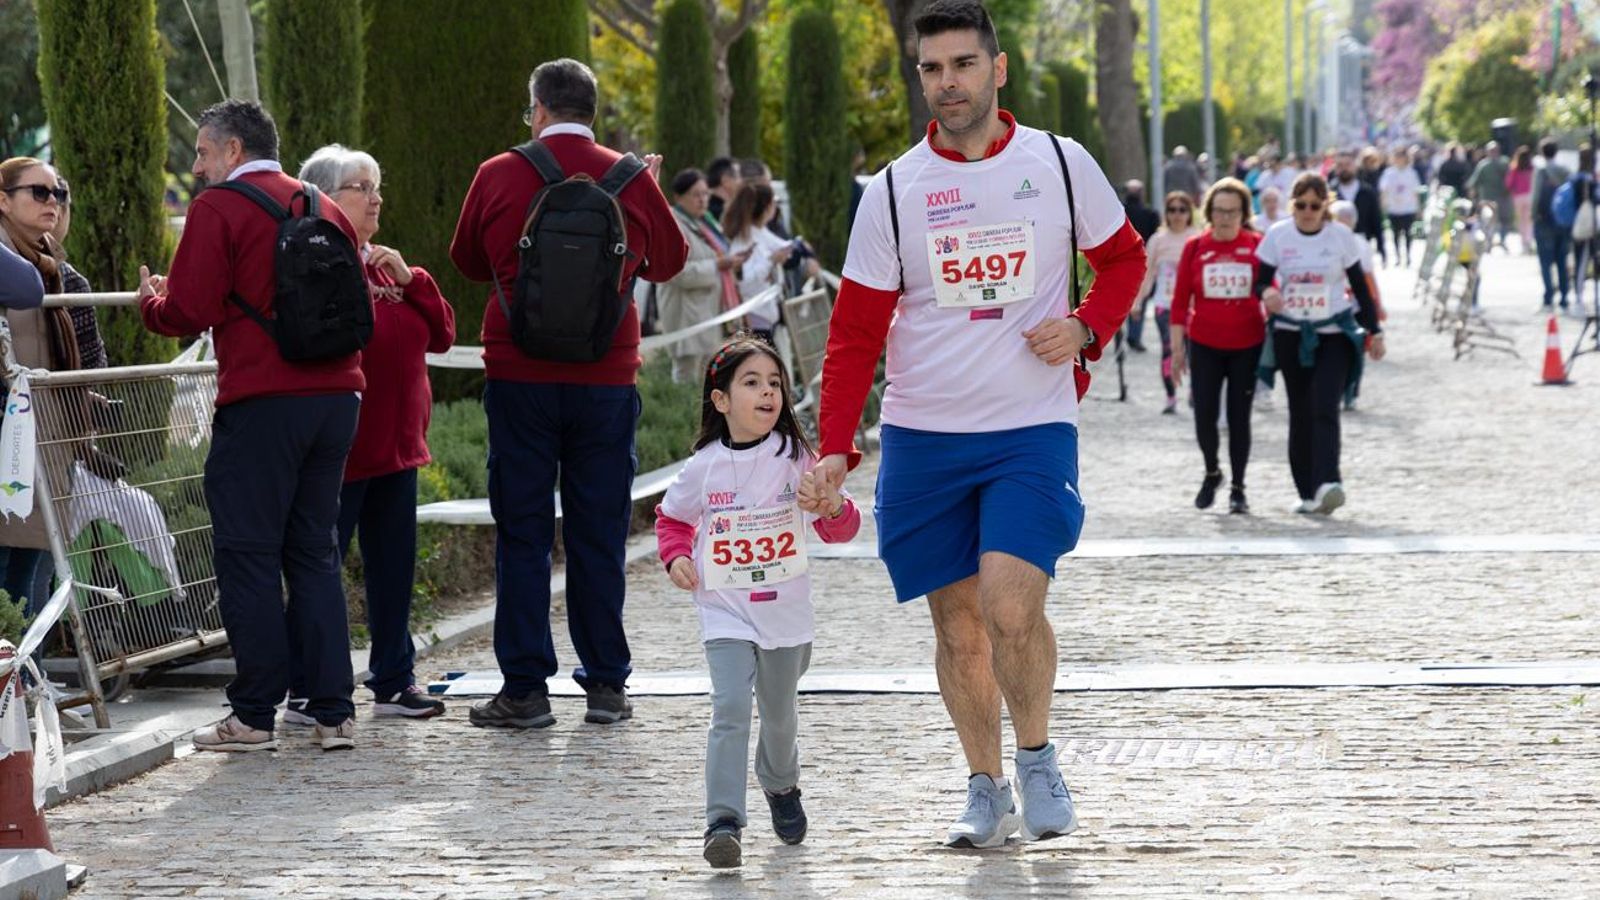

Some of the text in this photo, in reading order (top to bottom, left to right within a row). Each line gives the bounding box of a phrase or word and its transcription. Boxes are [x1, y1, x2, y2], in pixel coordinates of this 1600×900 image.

[926, 189, 961, 207] XXVII
[941, 250, 1027, 284] 5497
[1208, 275, 1248, 288] 5313
[1287, 296, 1325, 308] 5314
[12, 424, 22, 475] DEPORTES
[713, 532, 797, 565] 5332
